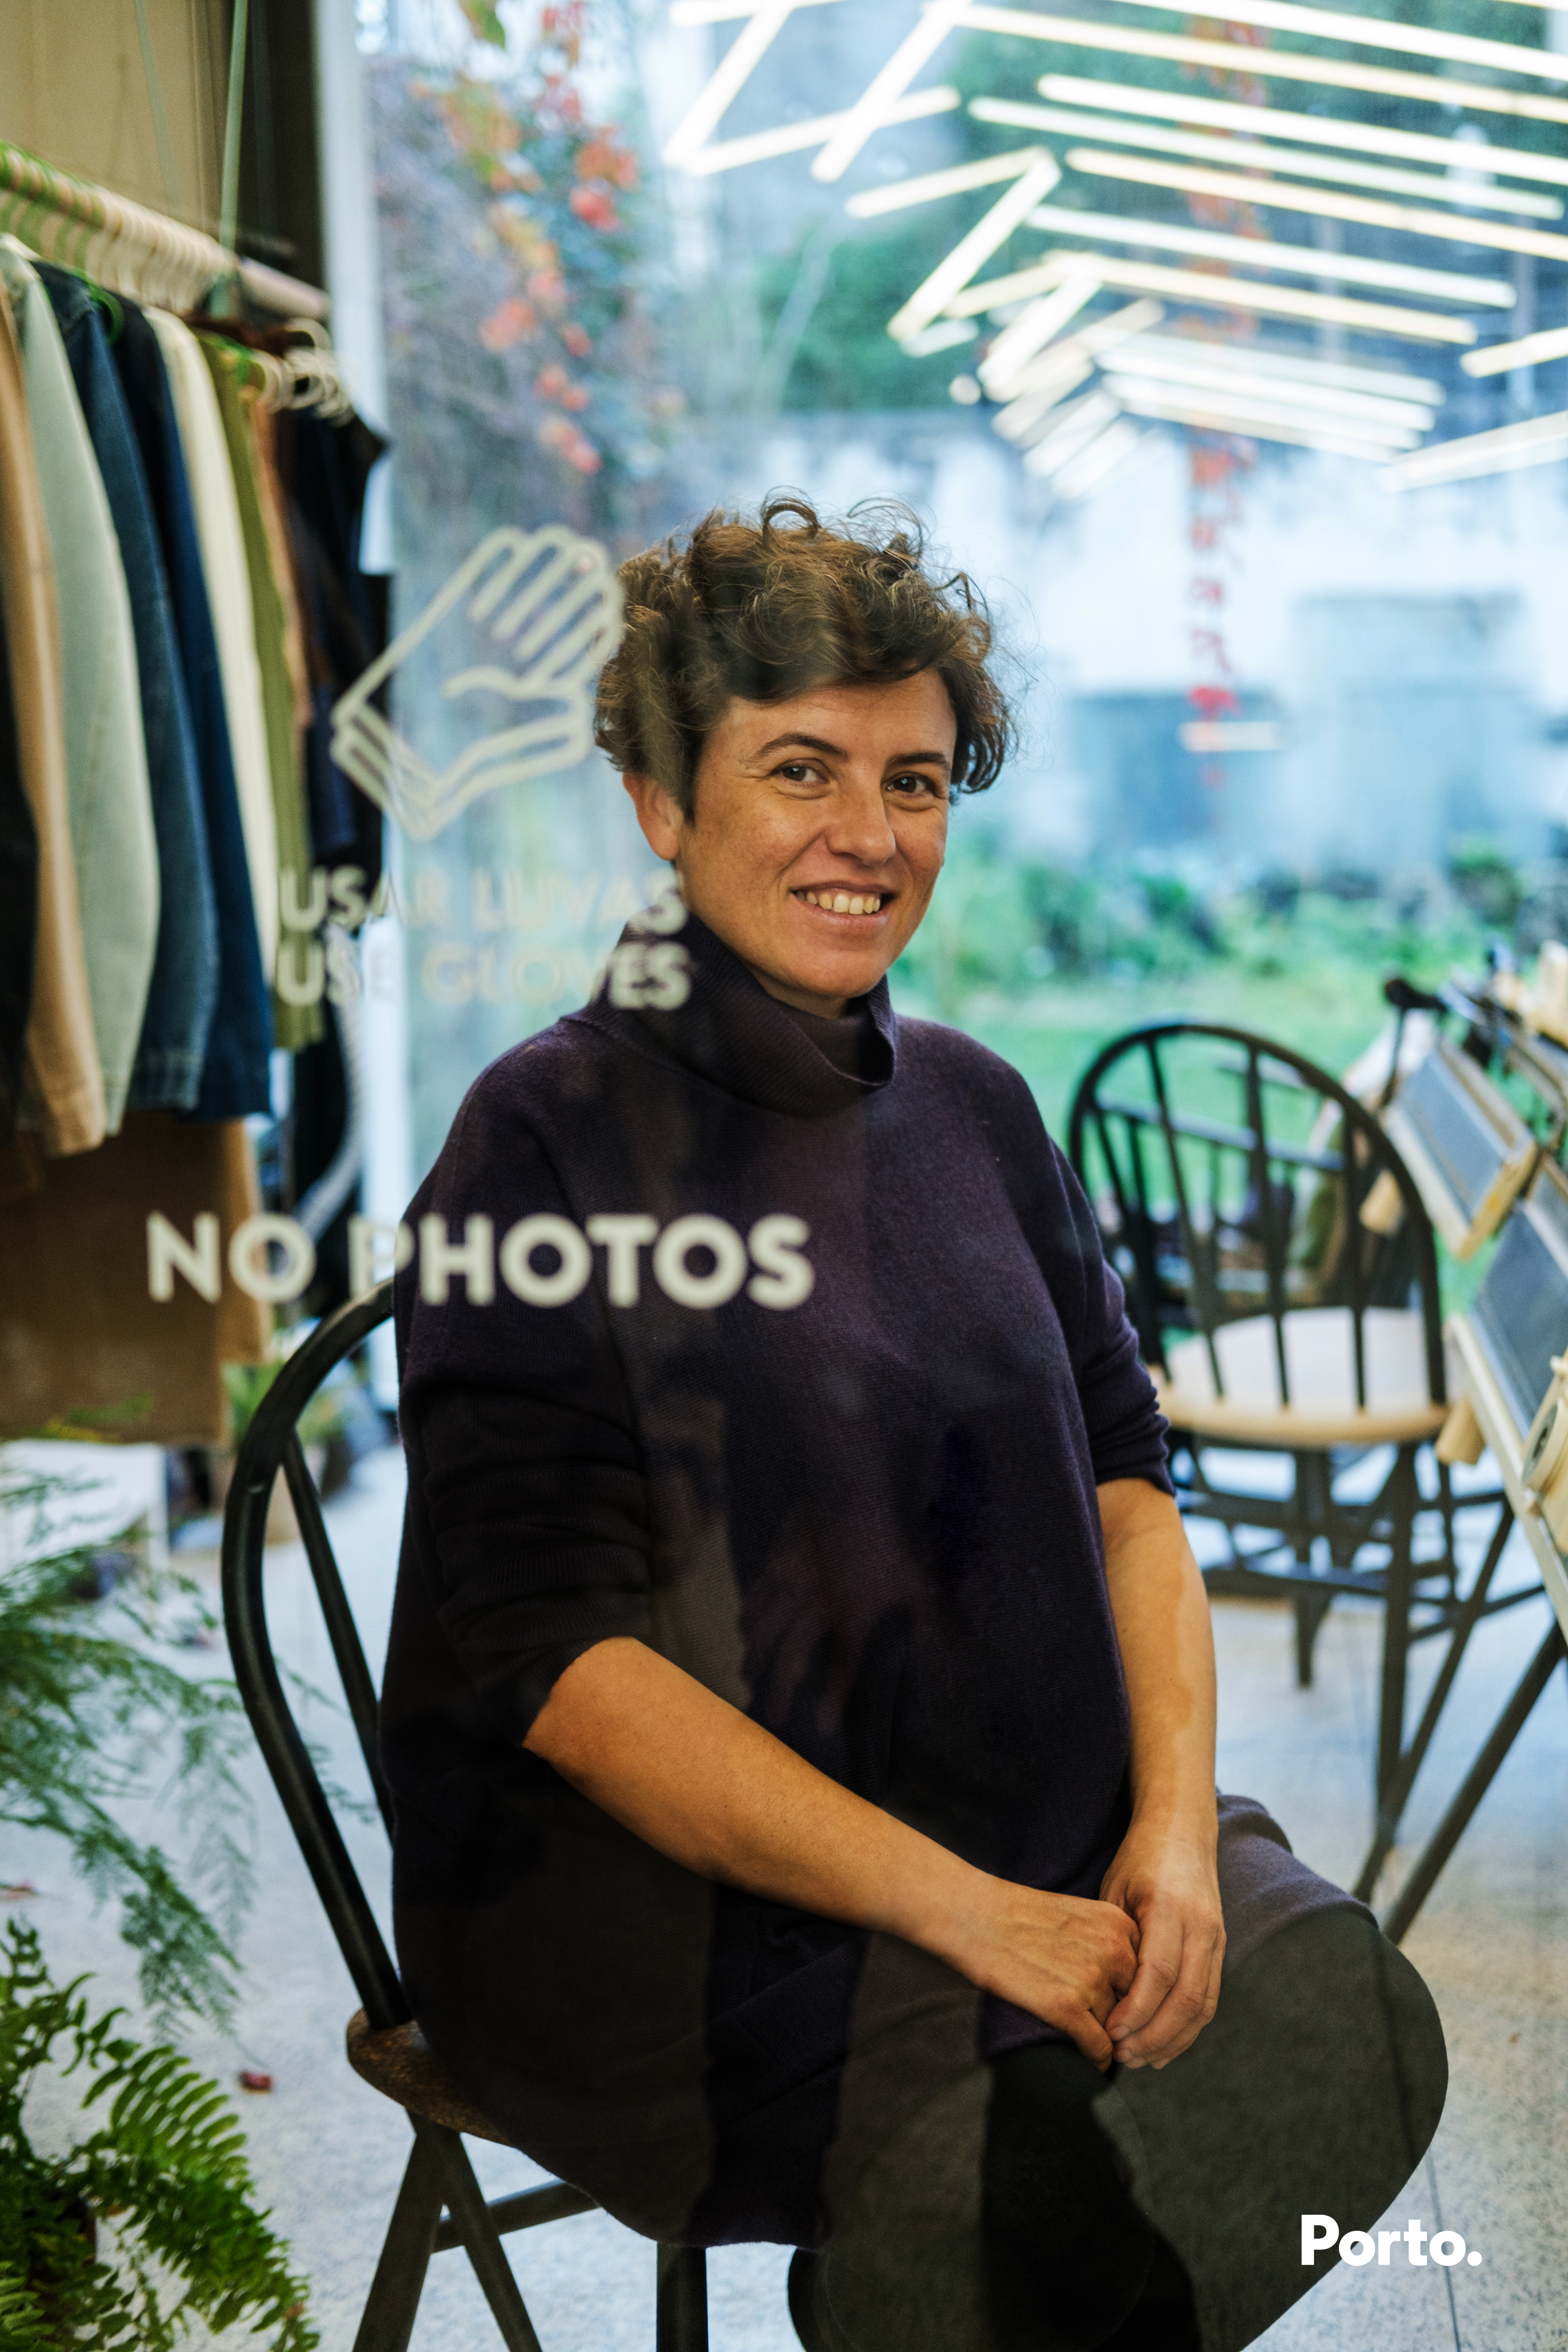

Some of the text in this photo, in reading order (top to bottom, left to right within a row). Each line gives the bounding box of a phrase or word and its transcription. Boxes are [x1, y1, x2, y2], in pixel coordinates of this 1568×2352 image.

[279, 866, 688, 935] USAR LUVAS
[277, 939, 691, 1011] USE GLOVES
[146, 1212, 814, 1310] NO PHOTOS
